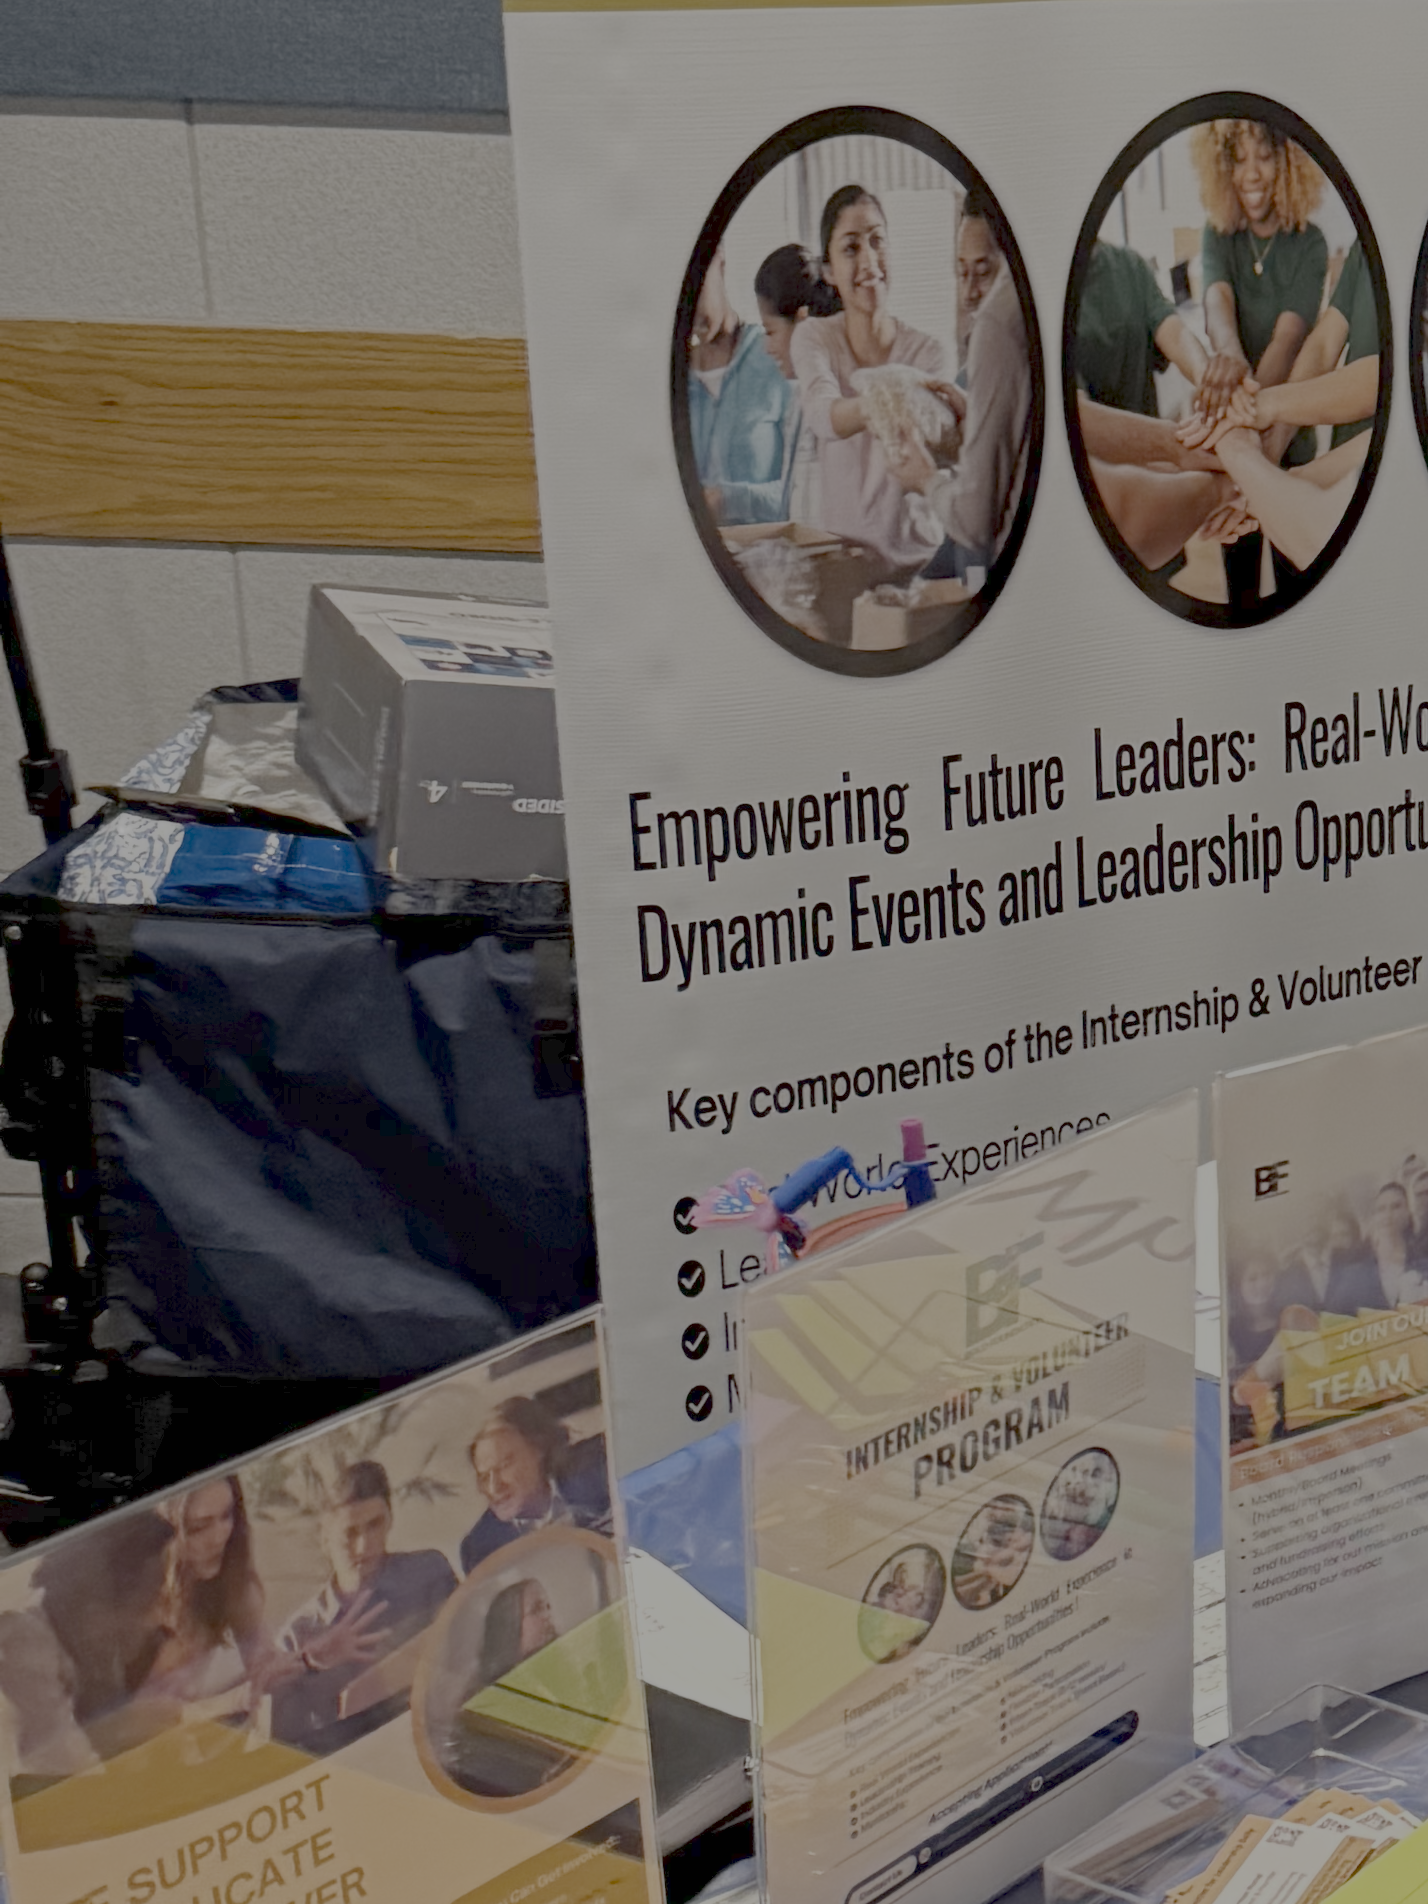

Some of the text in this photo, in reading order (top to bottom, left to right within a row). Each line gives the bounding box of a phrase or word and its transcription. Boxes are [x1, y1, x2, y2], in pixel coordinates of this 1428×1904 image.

[629, 774, 910, 884] Empowering
[941, 748, 1065, 835] Future
[1092, 720, 1257, 802] Leaders:
[637, 880, 835, 992] Dynamic
[848, 855, 986, 953] Events
[997, 835, 1065, 927] and
[1076, 802, 1284, 912] Leadership
[665, 1078, 741, 1135] Key
[749, 1045, 975, 1115] components
[984, 1030, 1020, 1075] of
[1024, 1021, 1073, 1071] the
[1079, 985, 1240, 1056] Internship
[1247, 981, 1271, 1019] &
[1276, 950, 1424, 1012] Volunteer
[845, 1312, 1131, 1481] INTERNSHIP & VOLUNTEER
[1307, 1352, 1412, 1411] TEAM
[1334, 1315, 1389, 1352] JOIN
[912, 1382, 1072, 1499] PROGRAM
[1004, 1585, 1060, 1634] Real-World
[125, 1775, 331, 1904] SUPPORT
